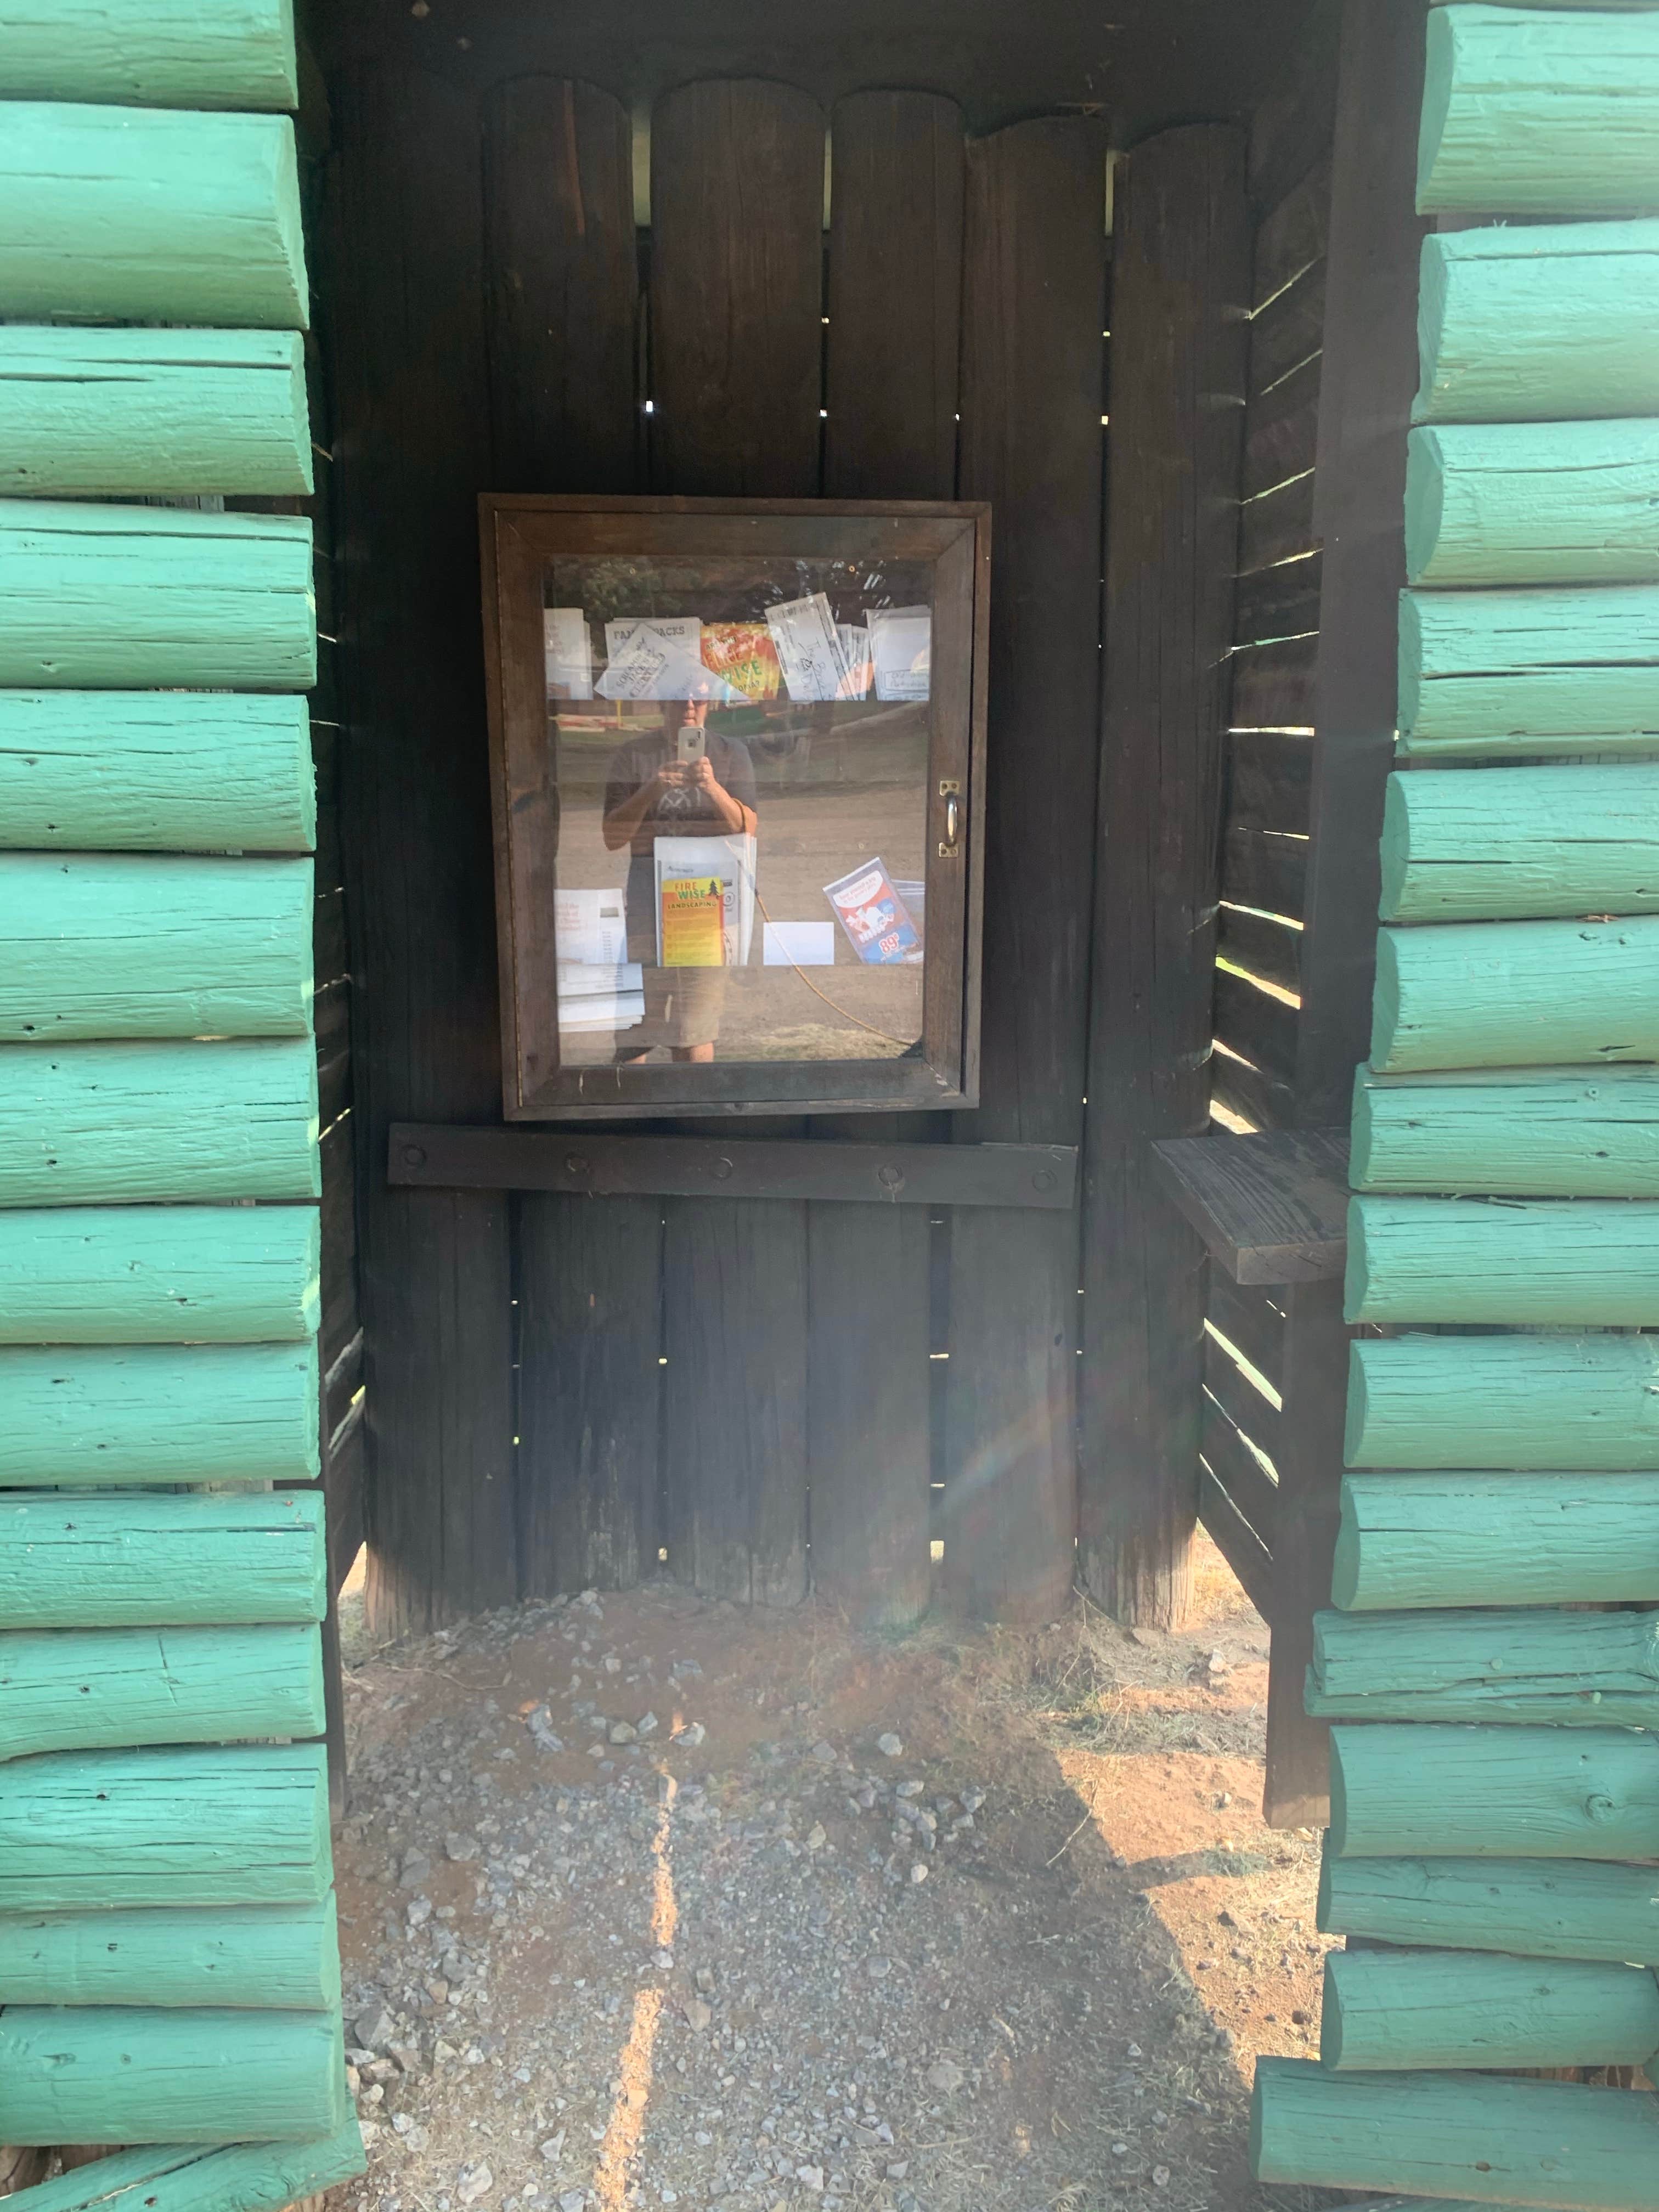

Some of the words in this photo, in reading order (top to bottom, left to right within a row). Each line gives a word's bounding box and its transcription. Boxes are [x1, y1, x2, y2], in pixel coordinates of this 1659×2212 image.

[721, 659, 762, 684] WISE
[675, 882, 697, 891] FIRE
[678, 890, 706, 899] WISE
[668, 901, 716, 909] LANDSCAPING
